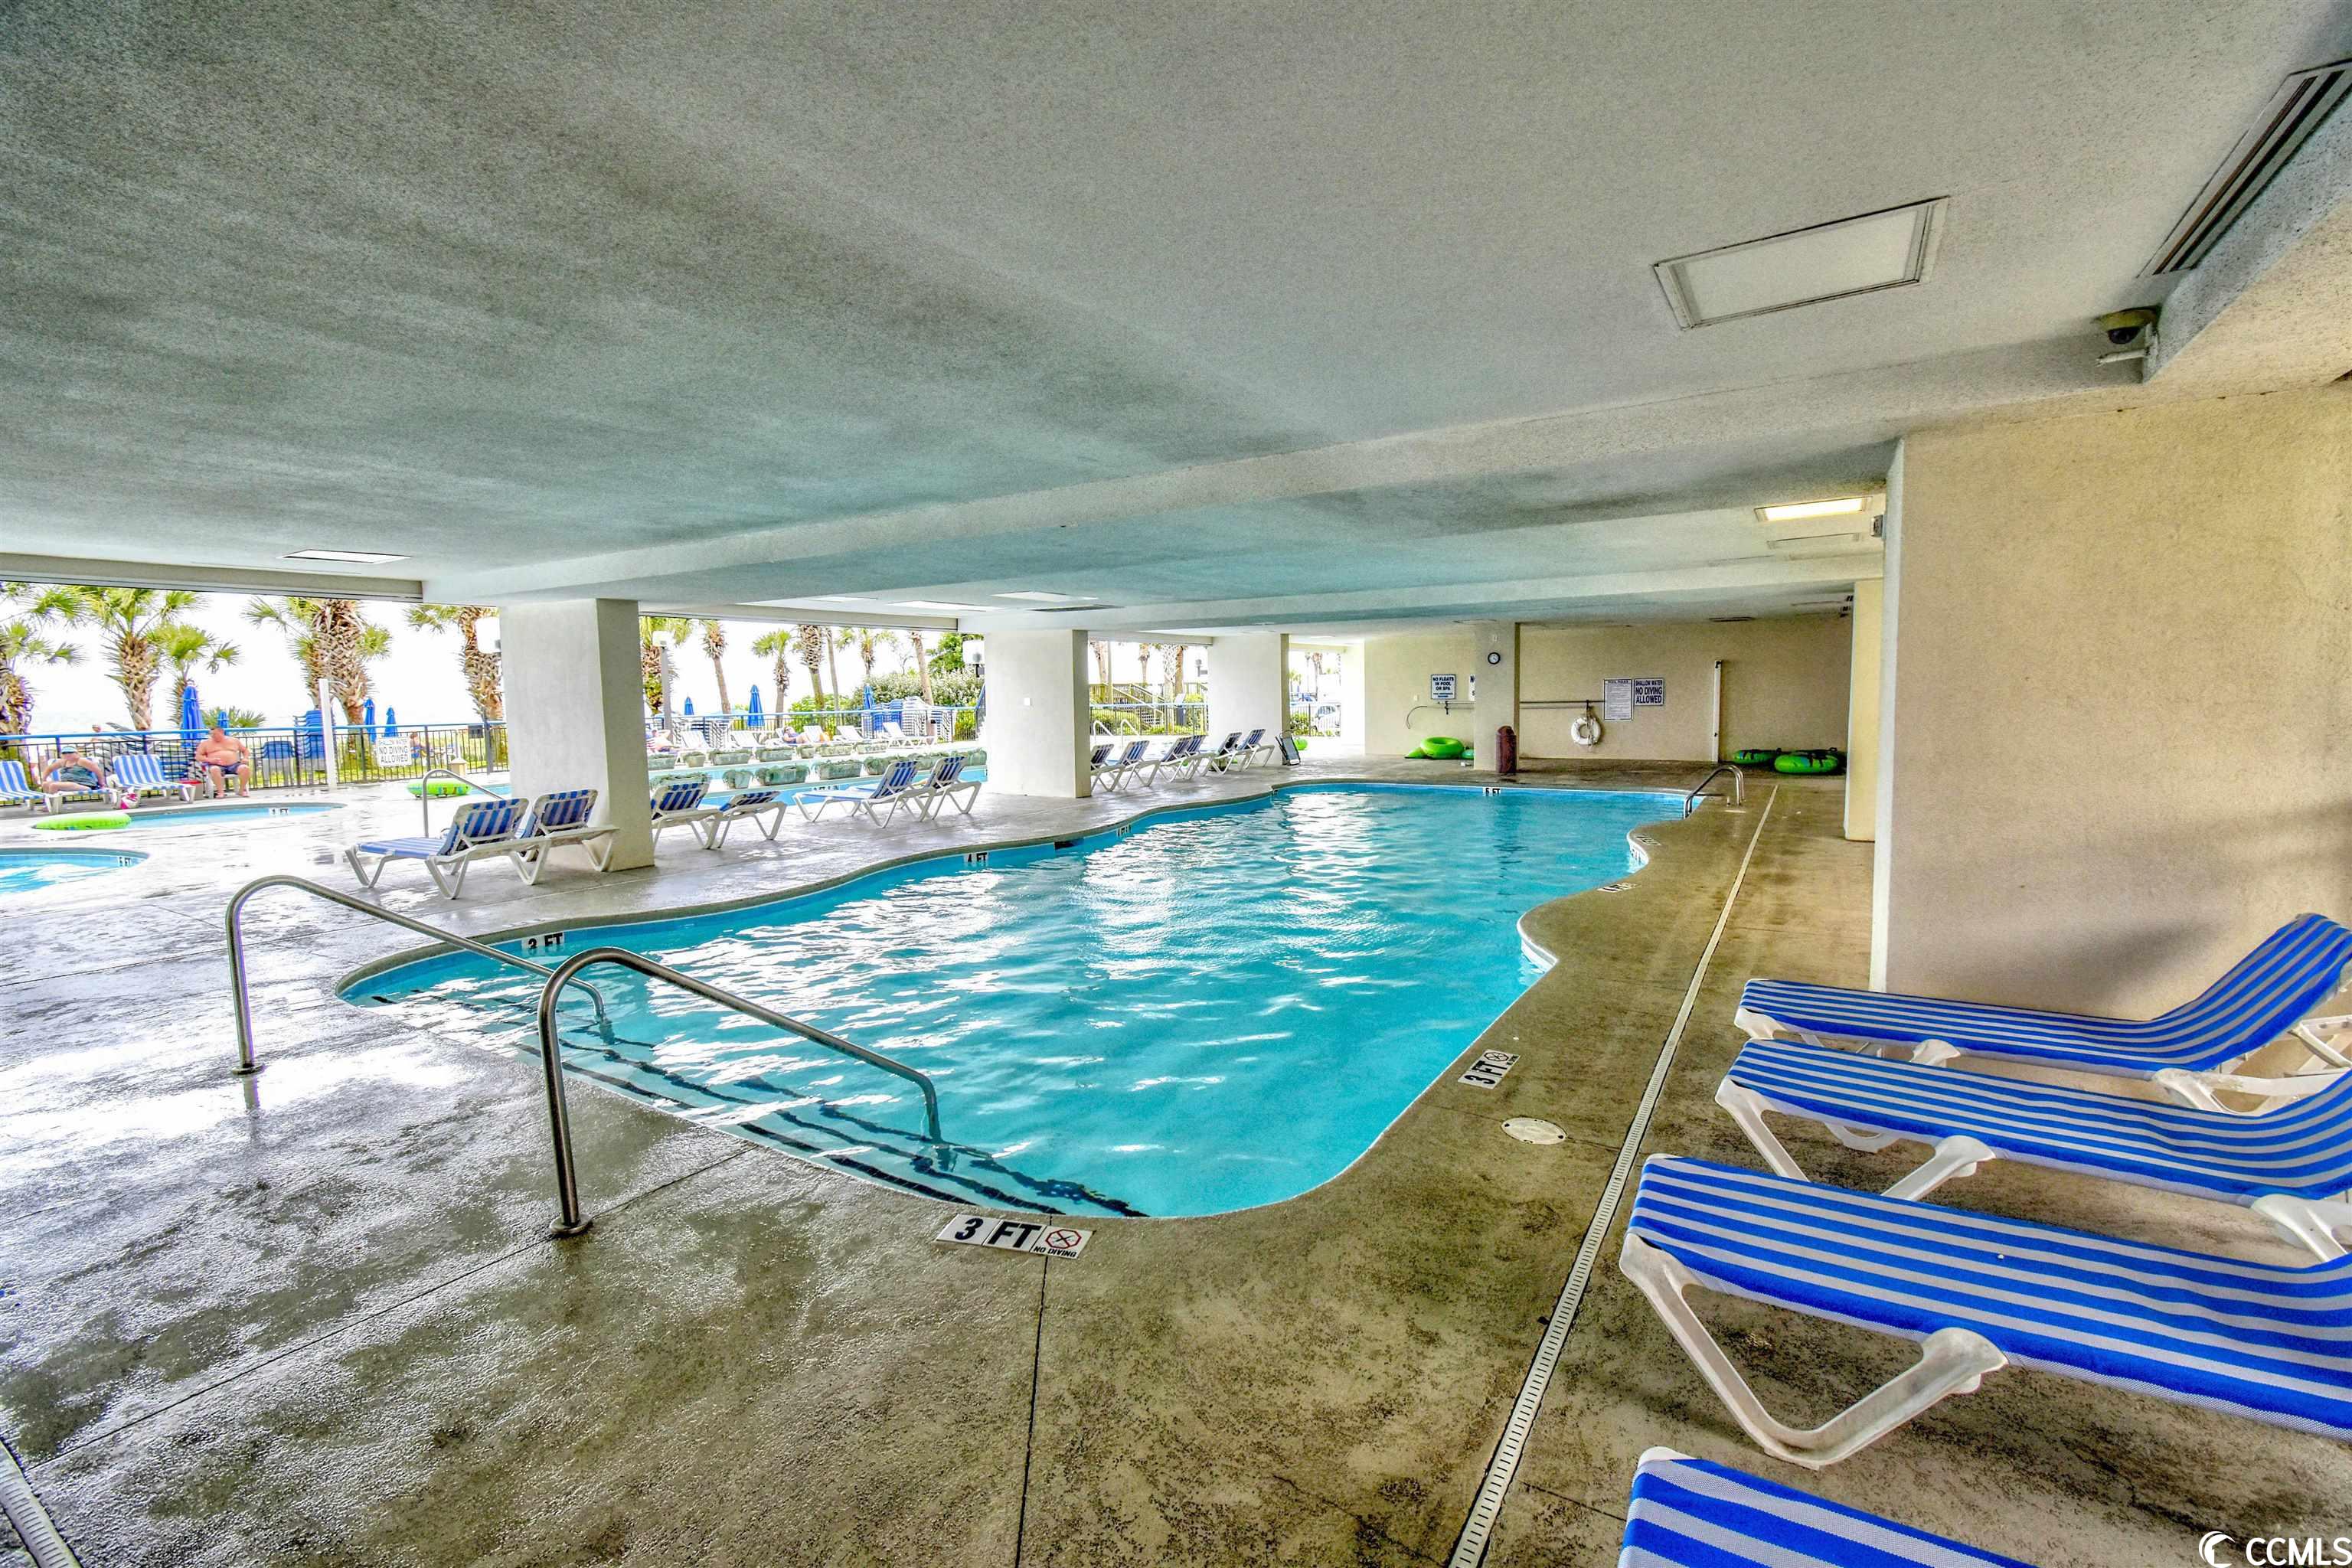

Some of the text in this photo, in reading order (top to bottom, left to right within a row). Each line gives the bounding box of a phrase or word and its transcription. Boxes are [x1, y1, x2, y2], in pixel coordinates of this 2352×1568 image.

[1636, 695, 1662, 704] ALLOWED
[381, 754, 409, 763] ALLOWED
[976, 852, 988, 862] FT
[544, 932, 563, 947] FT
[1464, 1060, 1508, 1085] 3 FT
[955, 1217, 1042, 1248] 3 FT
[1047, 1248, 1077, 1257] DIVING
